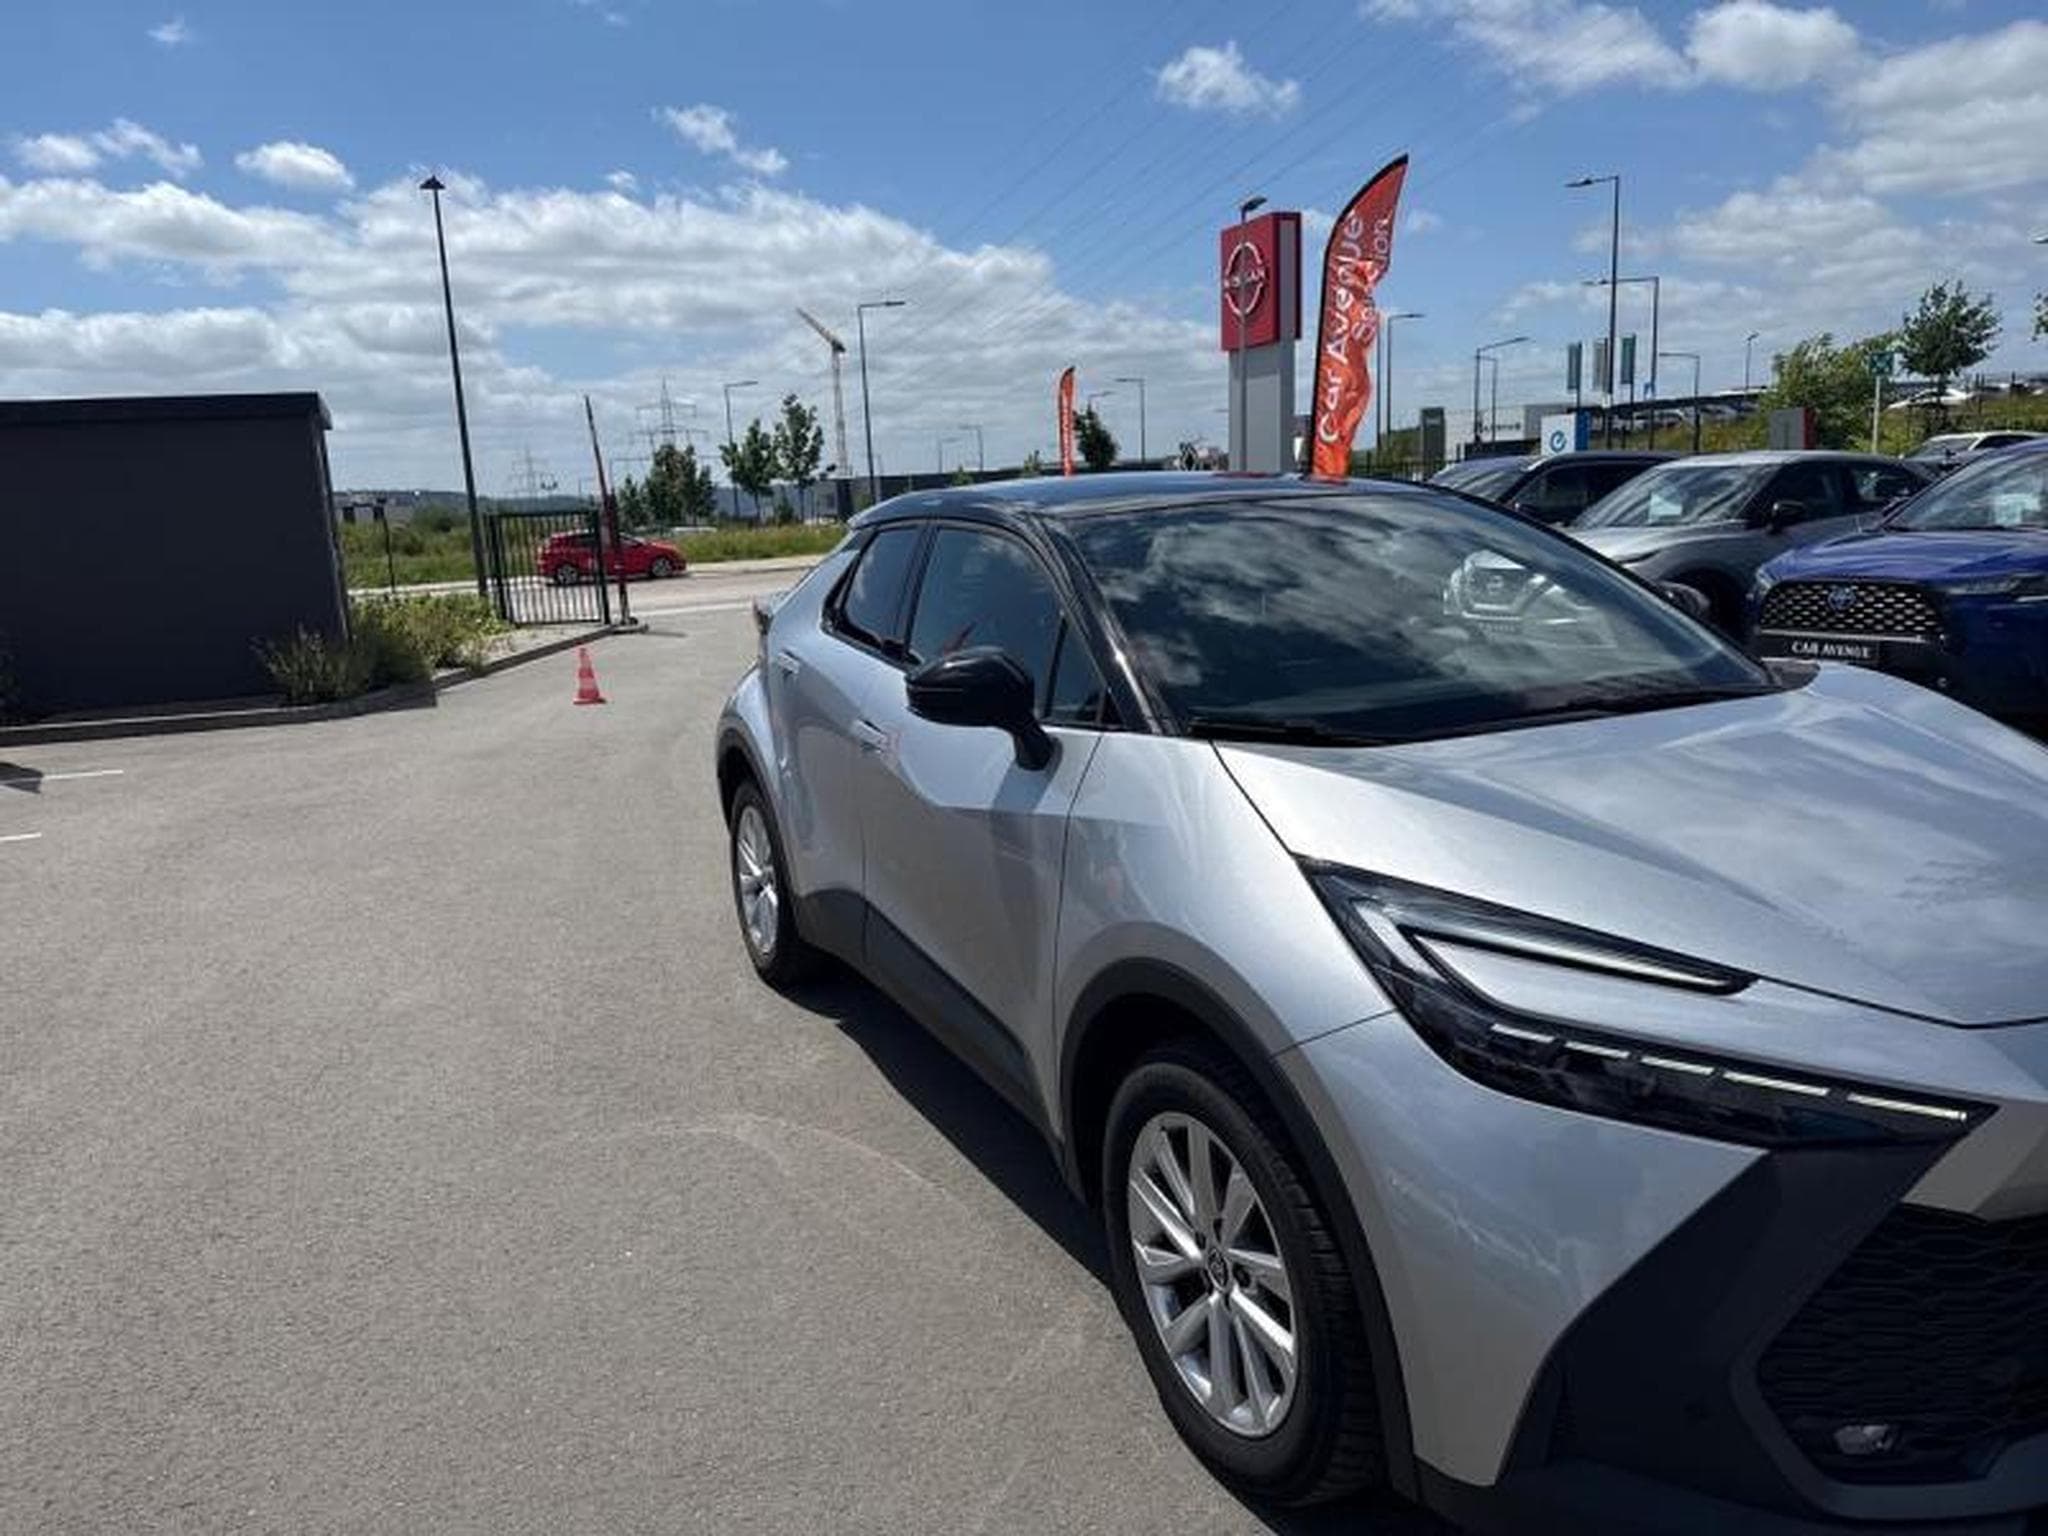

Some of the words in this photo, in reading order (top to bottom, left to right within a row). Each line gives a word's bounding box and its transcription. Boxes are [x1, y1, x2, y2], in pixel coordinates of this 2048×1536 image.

[1224, 269, 1266, 289] NSAN
[1326, 211, 1363, 366] Avenue
[1319, 368, 1343, 443] Car
[1791, 640, 1819, 655] CAR
[1820, 642, 1871, 658] AVENUE
